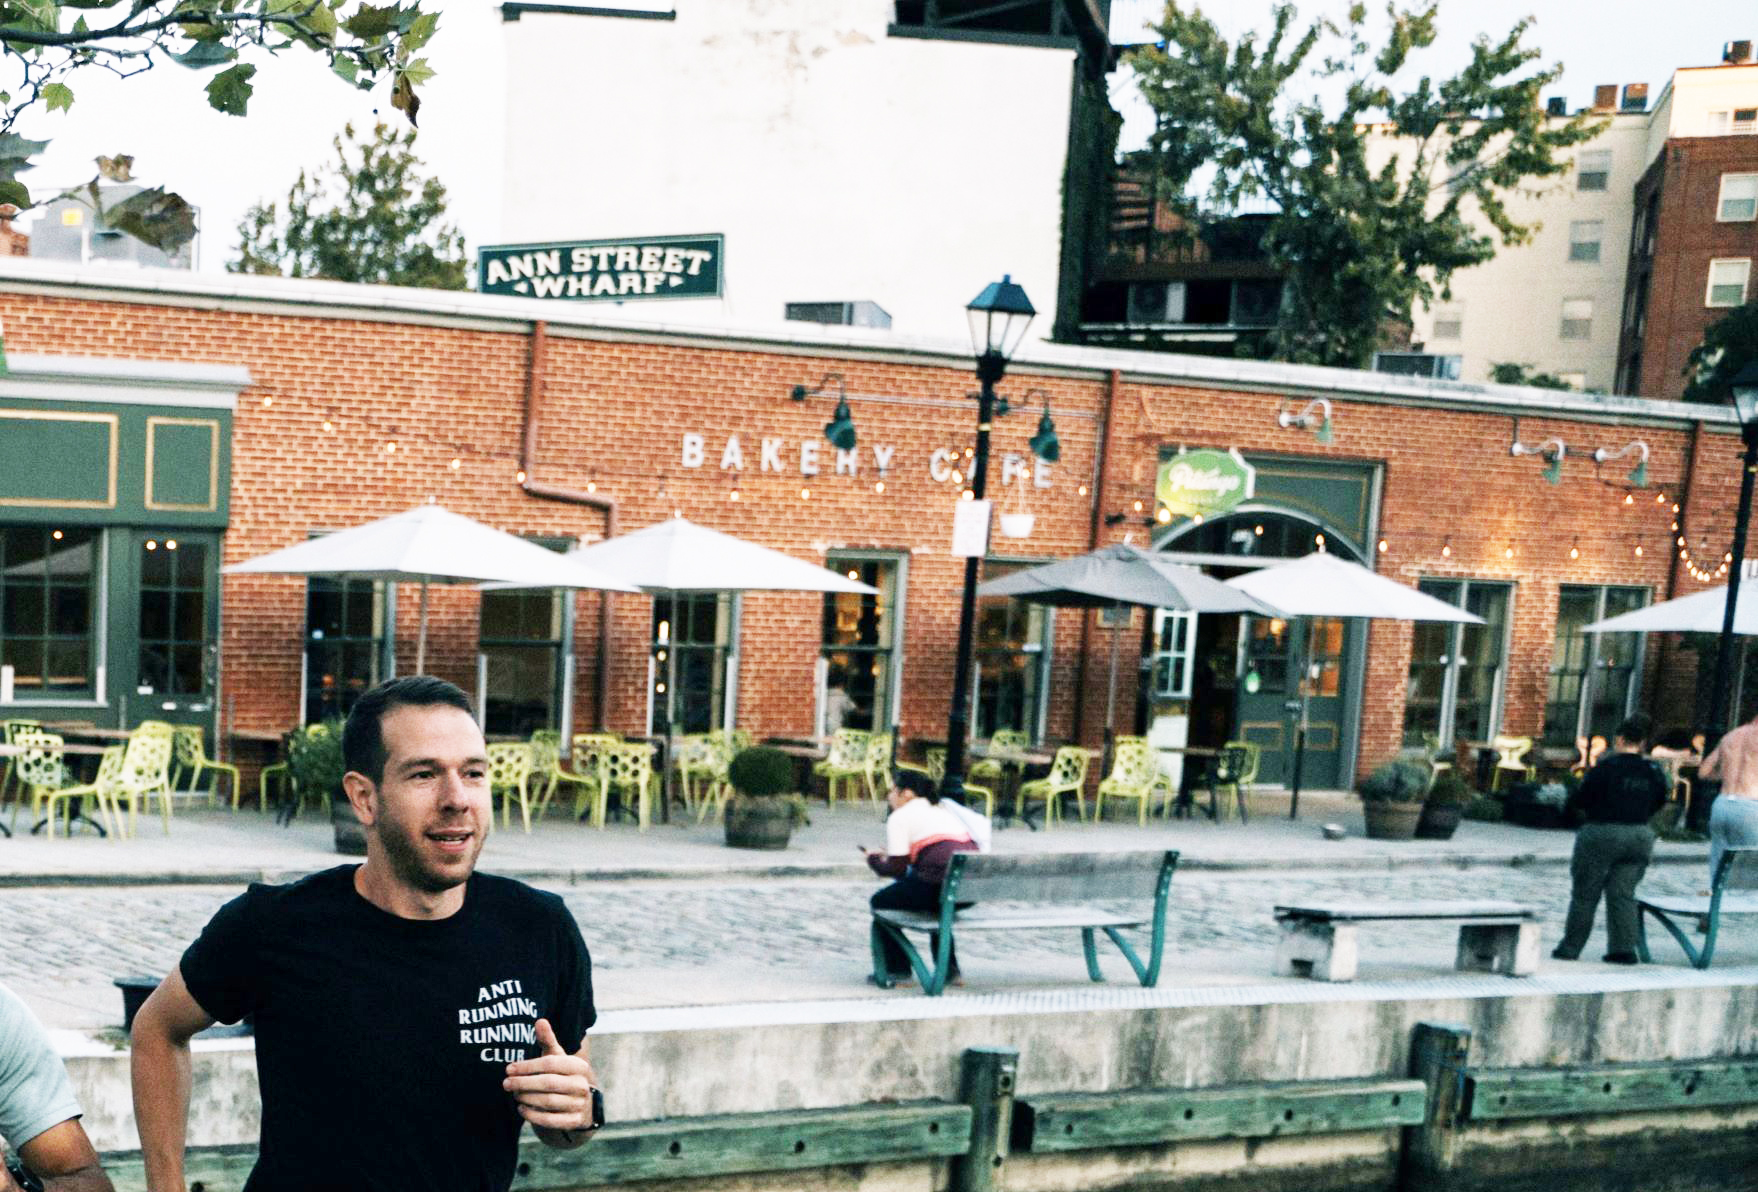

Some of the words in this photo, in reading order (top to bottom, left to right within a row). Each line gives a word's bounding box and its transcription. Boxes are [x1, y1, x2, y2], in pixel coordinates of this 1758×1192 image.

[487, 250, 561, 286] ANN
[571, 246, 712, 276] STREET
[531, 271, 667, 298] WHARF
[681, 432, 895, 480] BAKERY
[478, 980, 523, 1003] ANTI
[458, 997, 538, 1025] RUNNING
[459, 1022, 537, 1046] RUNNING
[480, 1047, 526, 1064] CLUB
